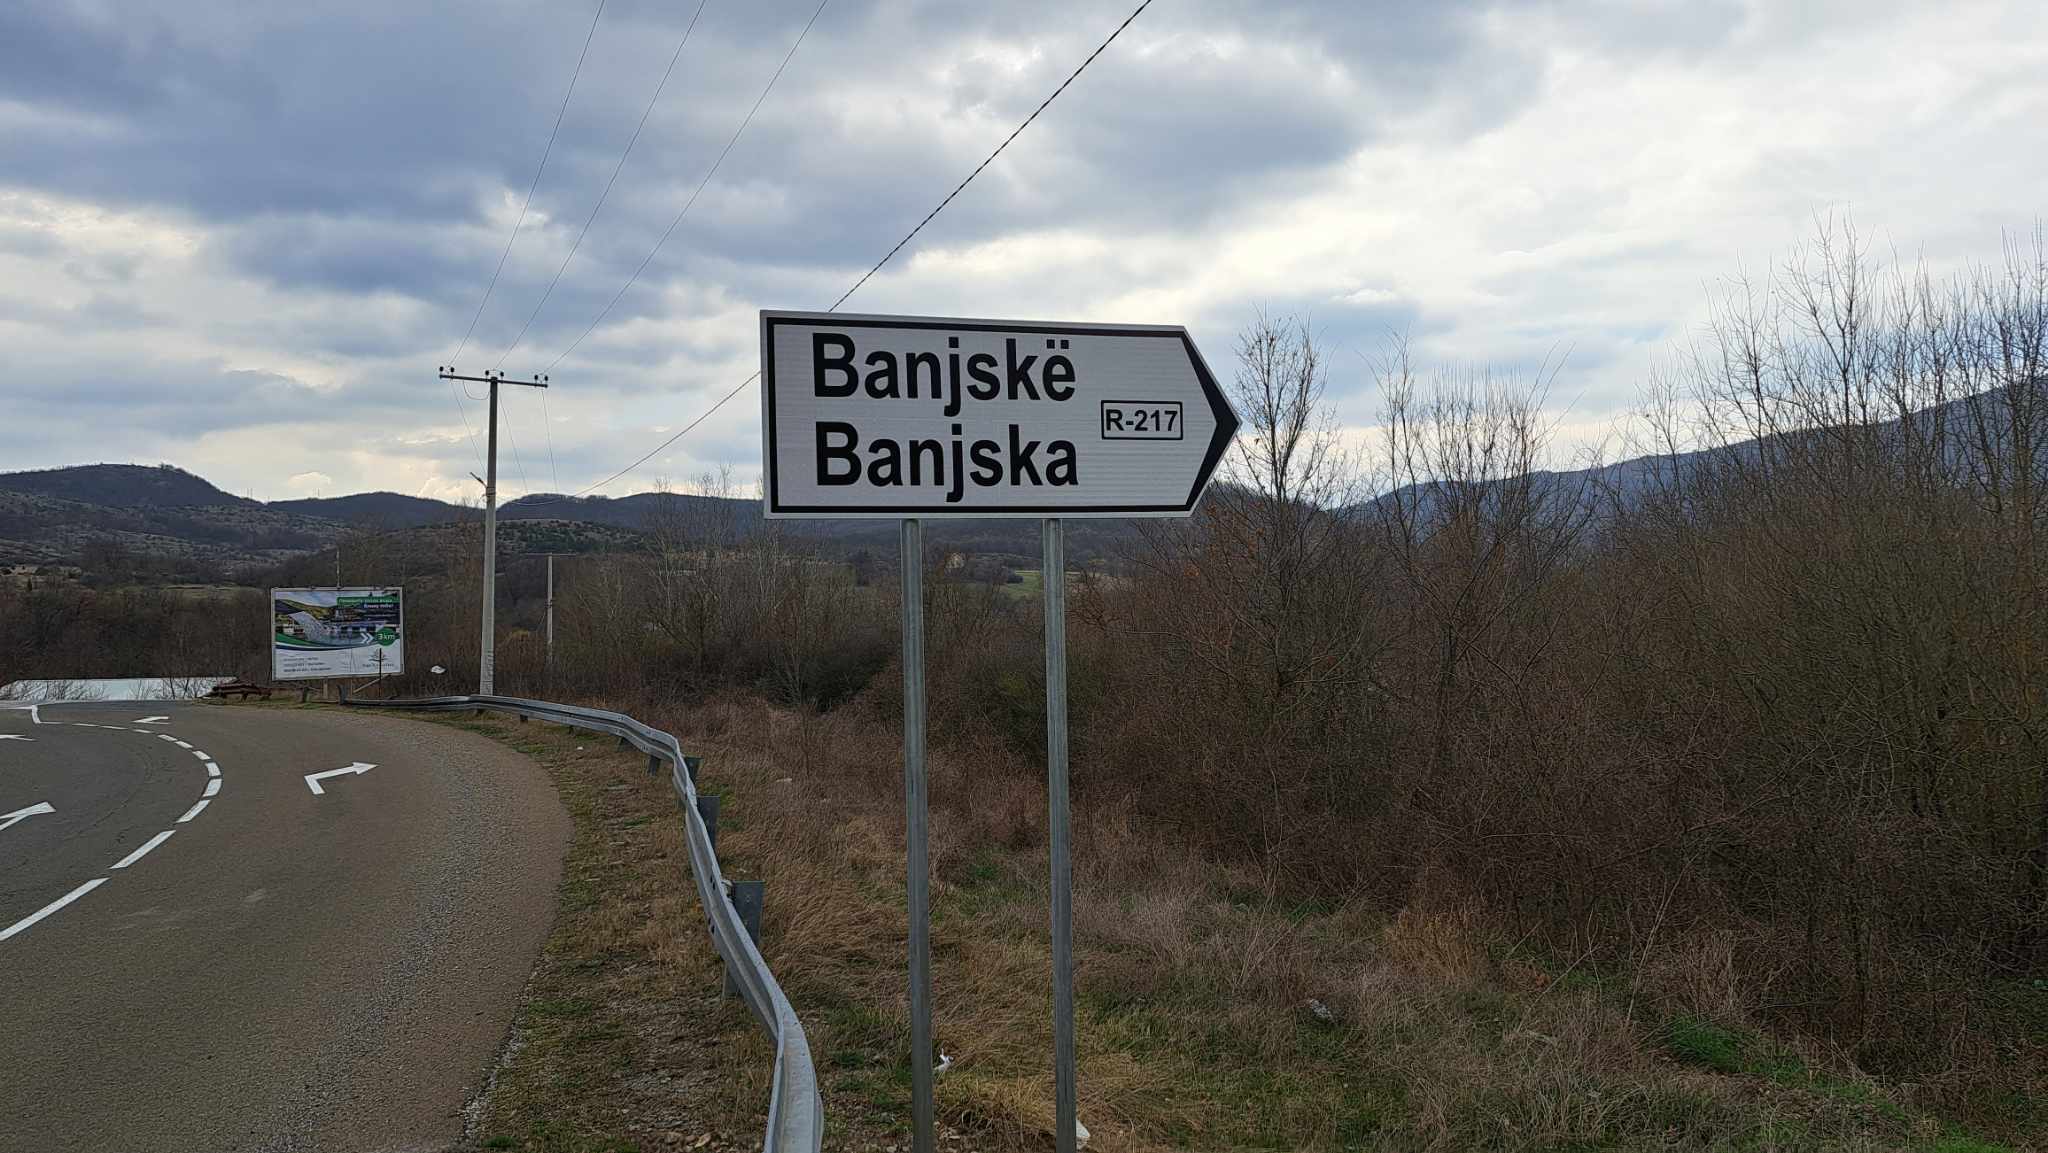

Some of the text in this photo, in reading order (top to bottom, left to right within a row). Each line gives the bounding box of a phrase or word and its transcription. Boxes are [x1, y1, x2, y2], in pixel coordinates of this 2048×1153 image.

[811, 332, 1076, 418] Banjskë
[815, 420, 1079, 503] Banjska
[1105, 408, 1179, 432] R-217
